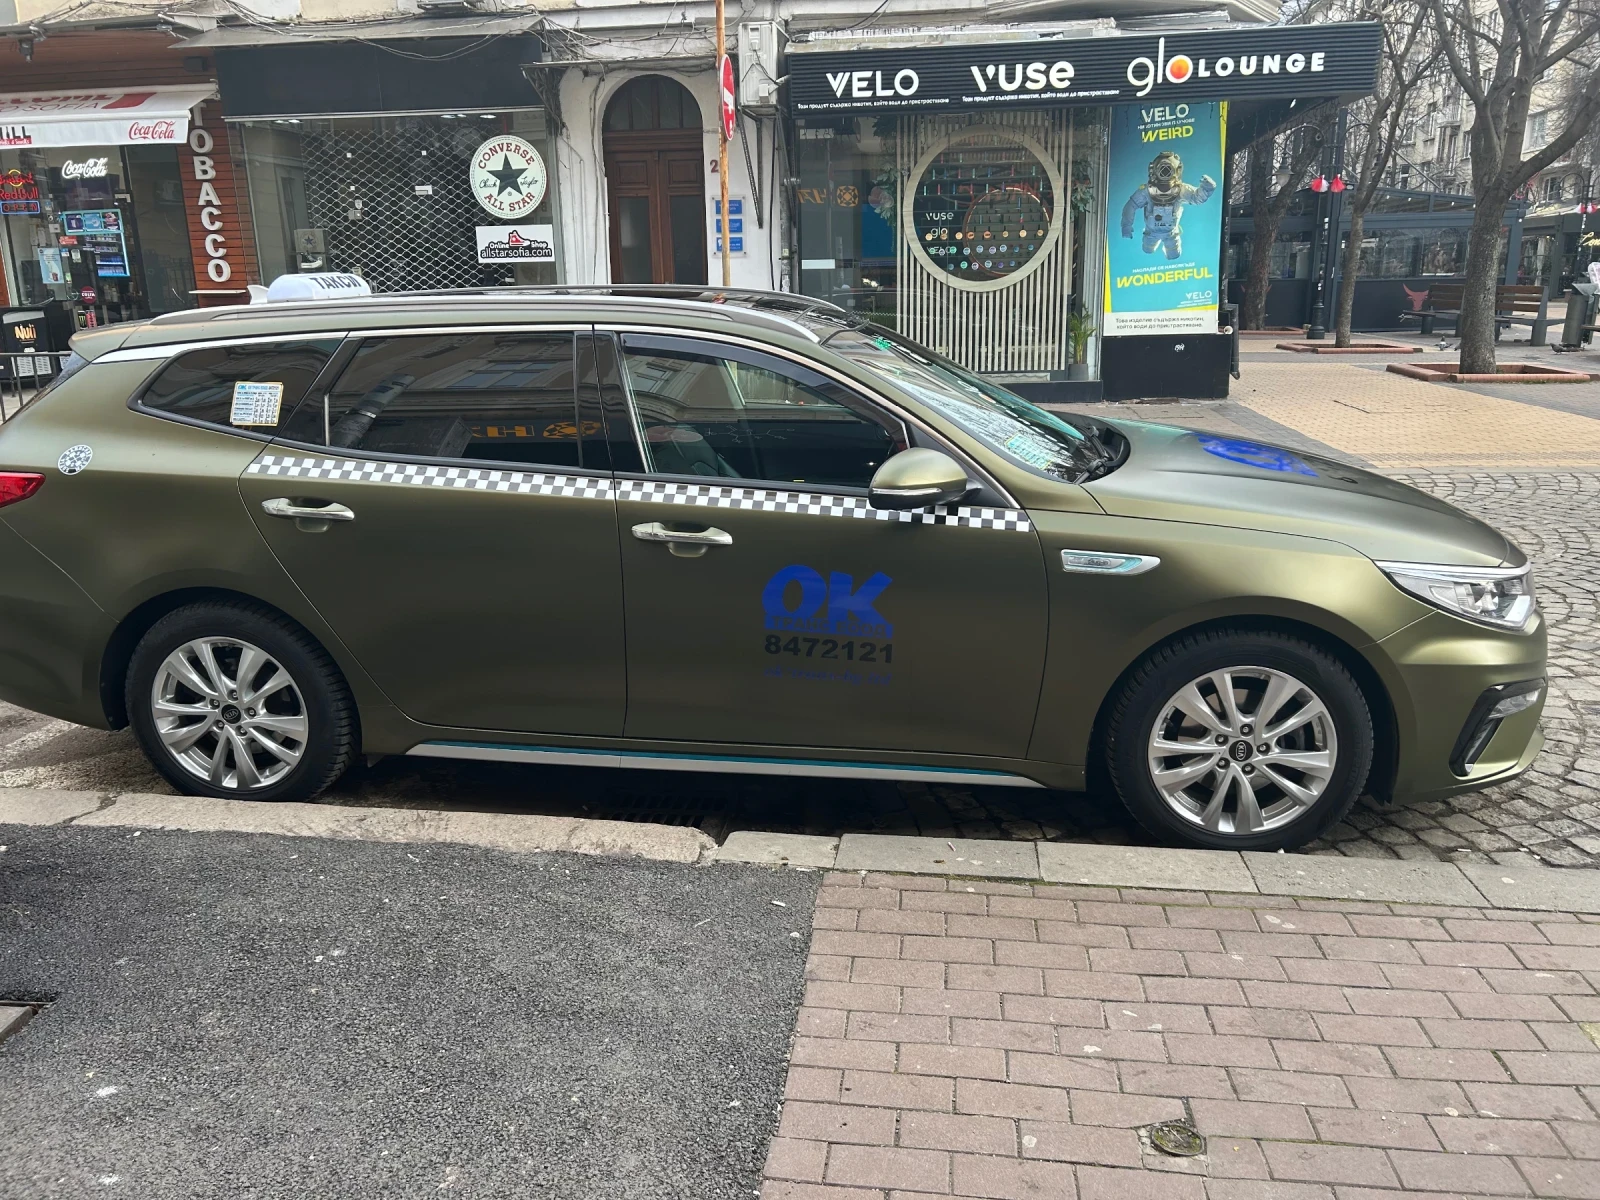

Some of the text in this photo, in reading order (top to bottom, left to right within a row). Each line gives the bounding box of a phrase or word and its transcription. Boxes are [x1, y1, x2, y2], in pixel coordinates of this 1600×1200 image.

[1127, 37, 1193, 97] glo
[1197, 52, 1325, 78] LOUNGE
[825, 68, 919, 98] VELO
[22, 102, 99, 112] SOFIA
[1141, 103, 1189, 123] VELO
[128, 121, 176, 140] Coca-Cola
[1142, 125, 1193, 143] WEIRD
[478, 142, 535, 170] CONVERSE
[62, 158, 108, 179] Coca-Cola
[190, 101, 232, 283] TOBACCO
[484, 193, 505, 212] ALL
[508, 191, 536, 212] STAR
[481, 247, 552, 258] allstarsofia.com
[489, 240, 548, 250] Online Shop
[309, 275, 362, 290] ТАКСИ
[1116, 267, 1213, 289] WONDERFUL
[1186, 290, 1212, 300] VELO
[761, 564, 893, 624] OK
[764, 634, 893, 664] 8472121
